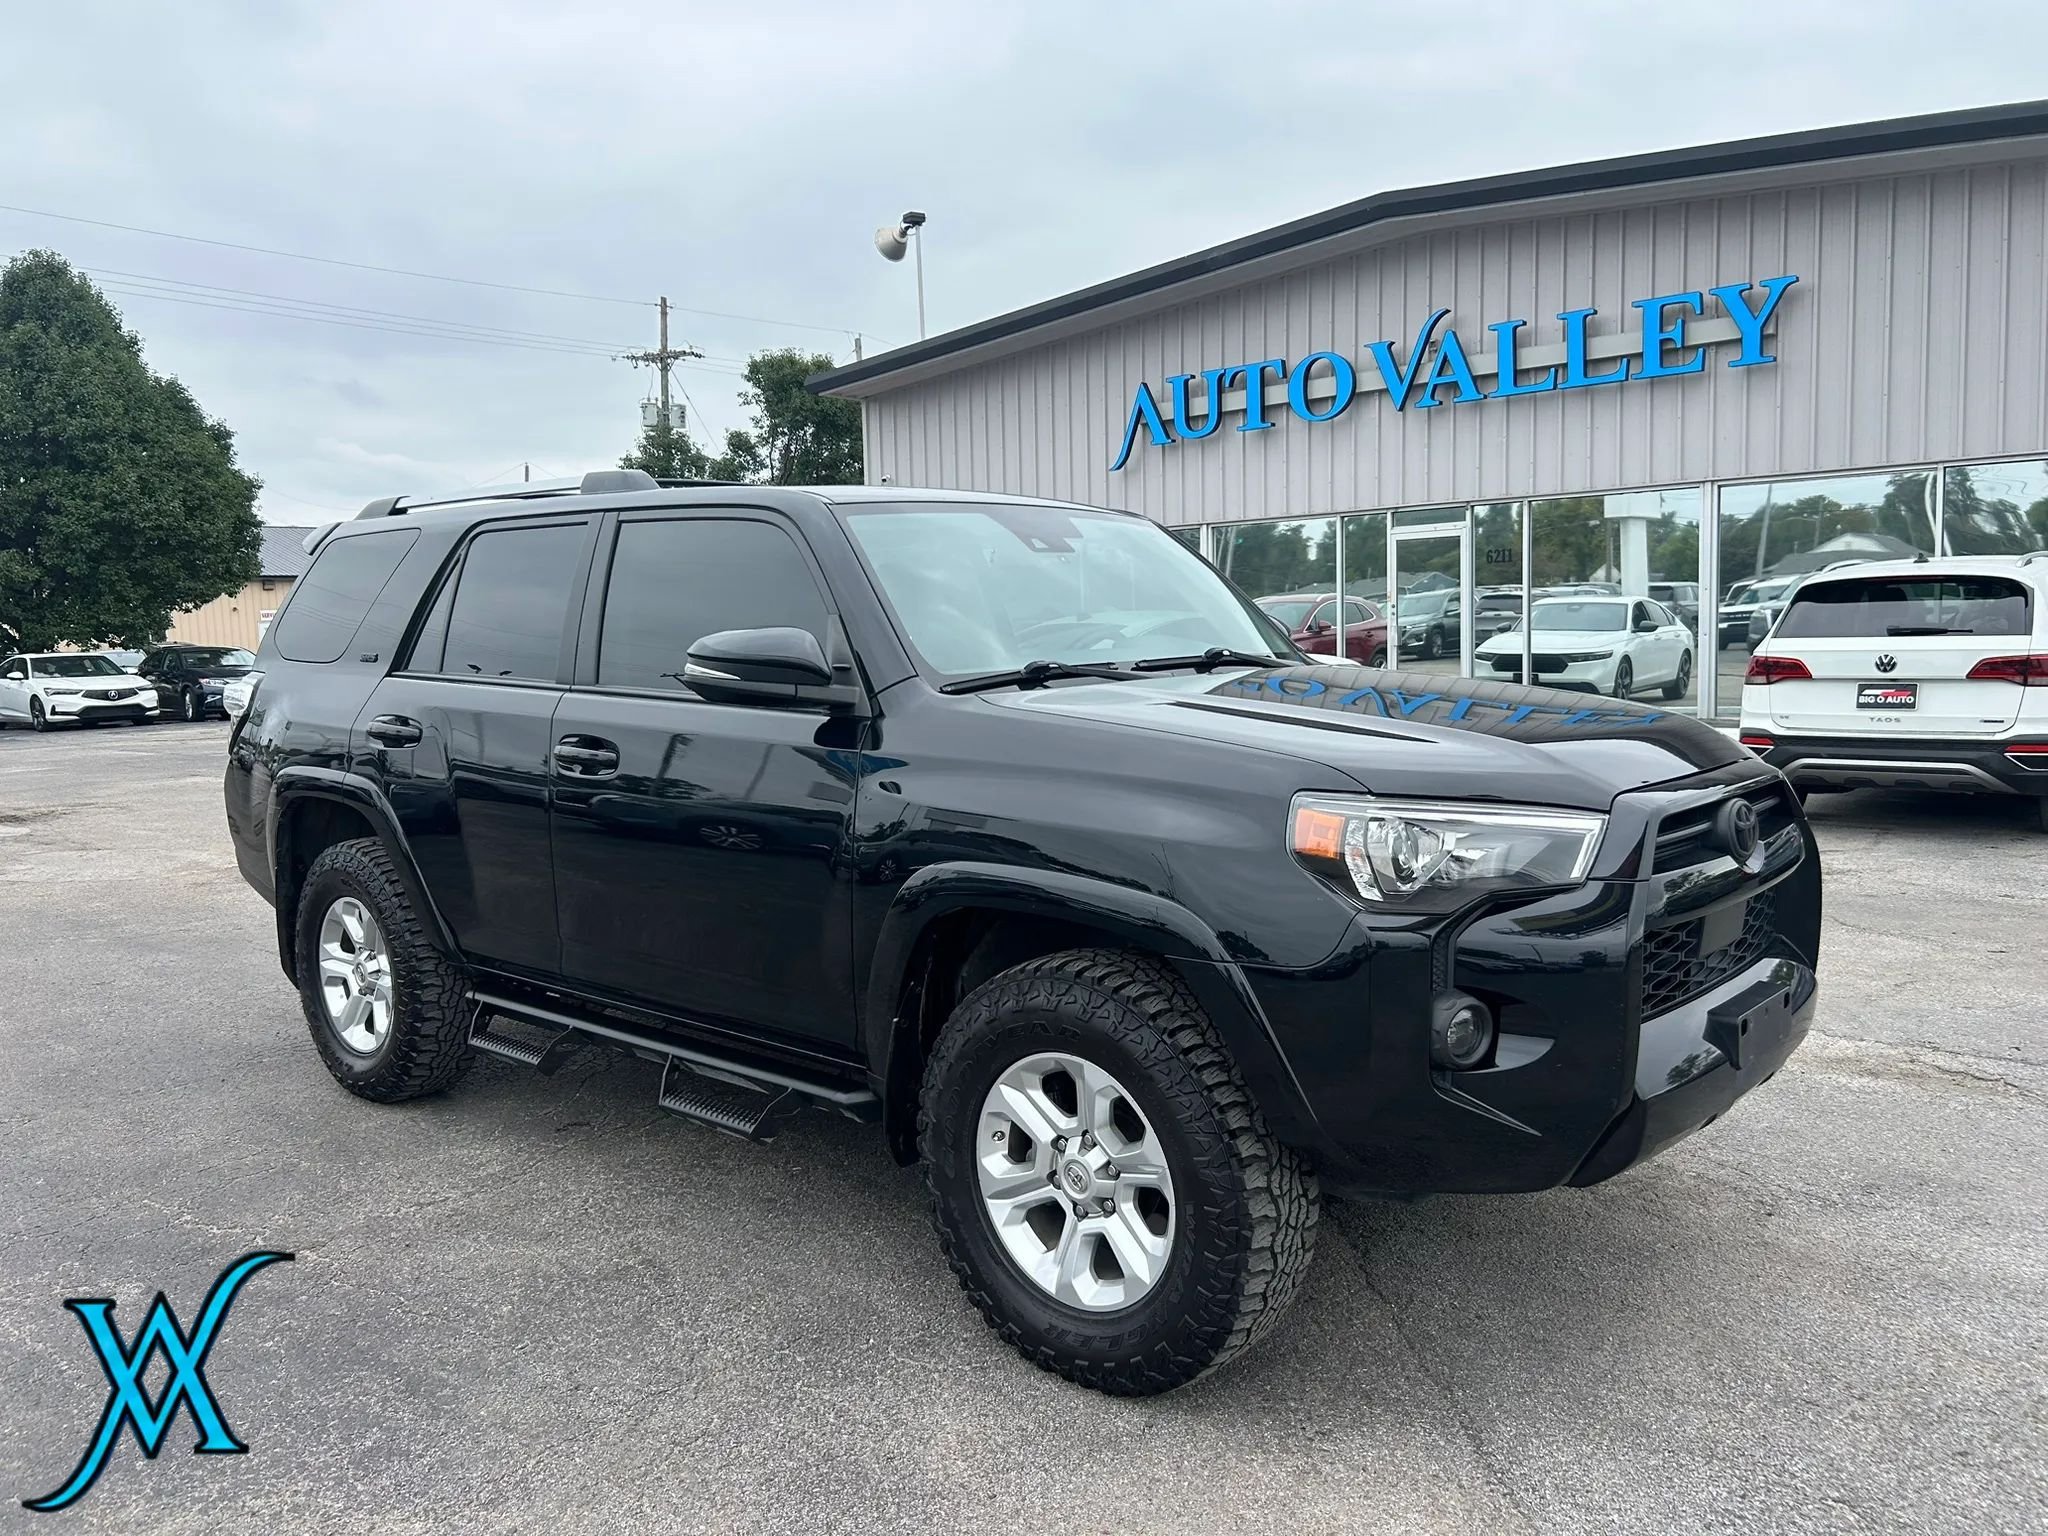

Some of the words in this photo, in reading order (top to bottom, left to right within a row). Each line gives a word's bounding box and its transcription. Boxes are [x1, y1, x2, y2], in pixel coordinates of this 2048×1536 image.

[1109, 351, 1356, 470] AUTO
[1364, 275, 1799, 412] VALLEY
[1486, 548, 1513, 565] 6211
[1858, 695, 1876, 704] BIG
[1876, 695, 1885, 704] O
[1885, 695, 1914, 704] AUTO
